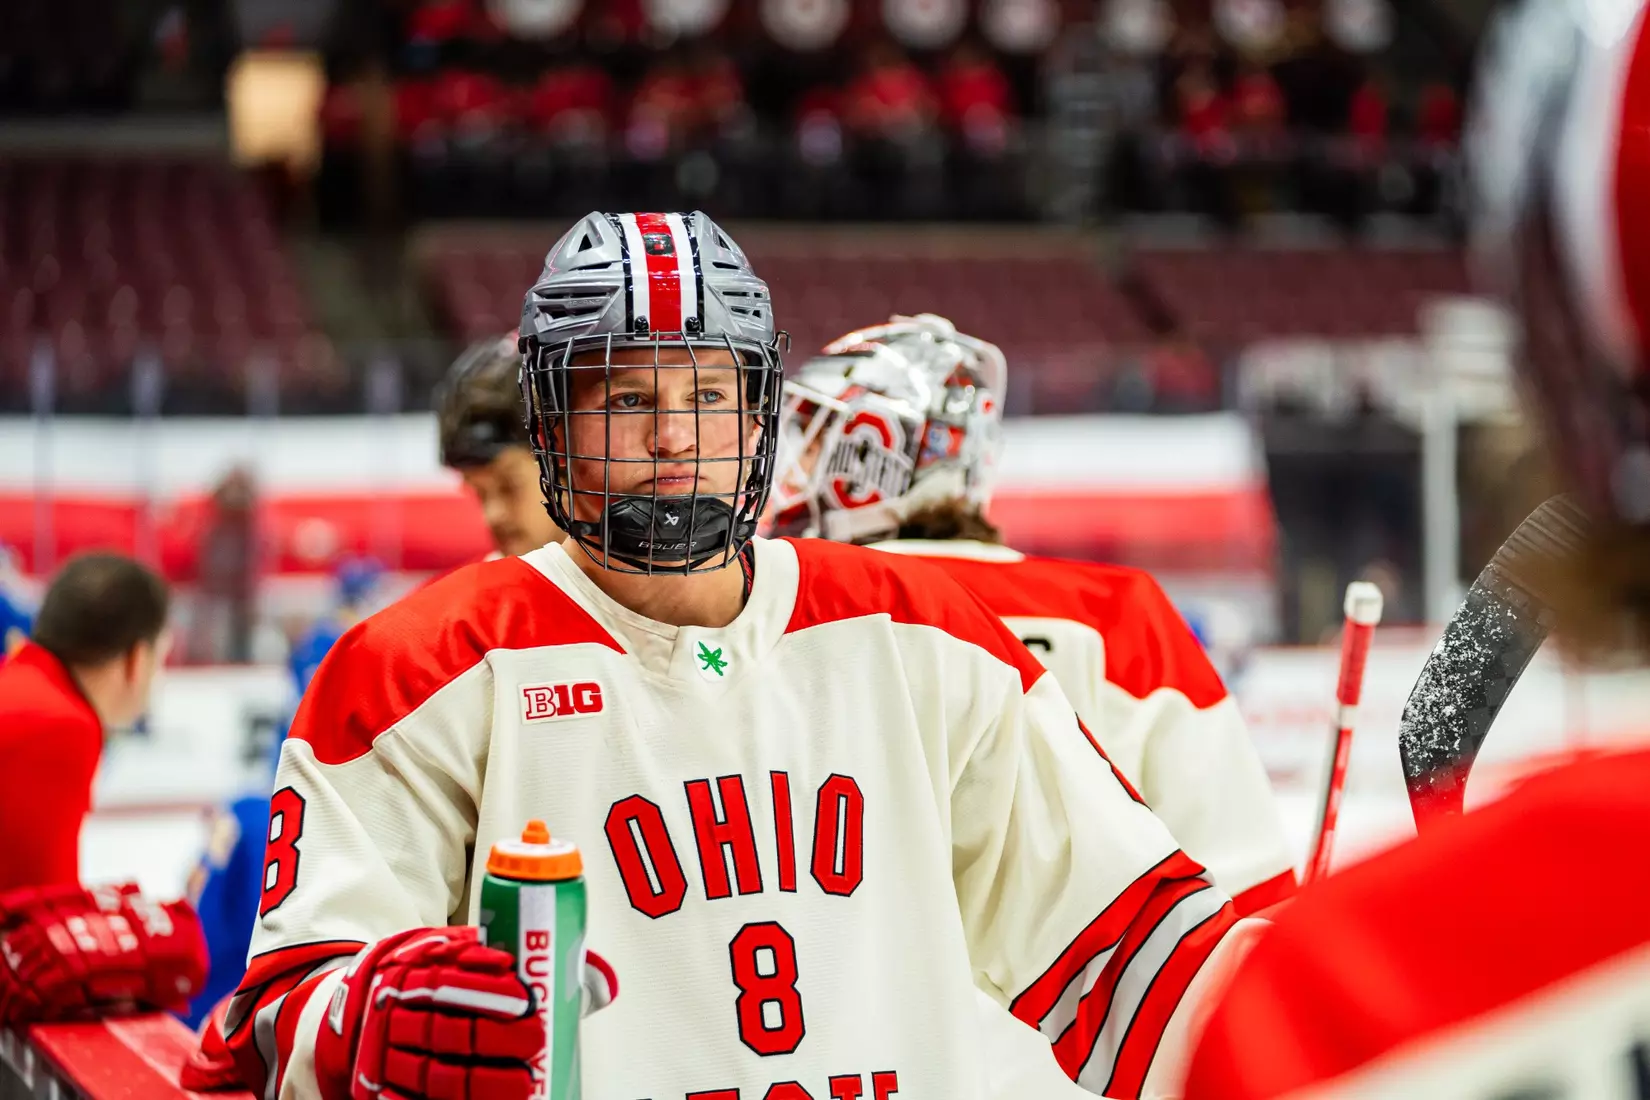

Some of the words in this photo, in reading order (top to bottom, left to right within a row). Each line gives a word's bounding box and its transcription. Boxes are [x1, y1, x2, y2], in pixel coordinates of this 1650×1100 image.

[638, 541, 697, 551] BAUER
[604, 770, 864, 919] OHIO
[729, 920, 806, 1057] 8
